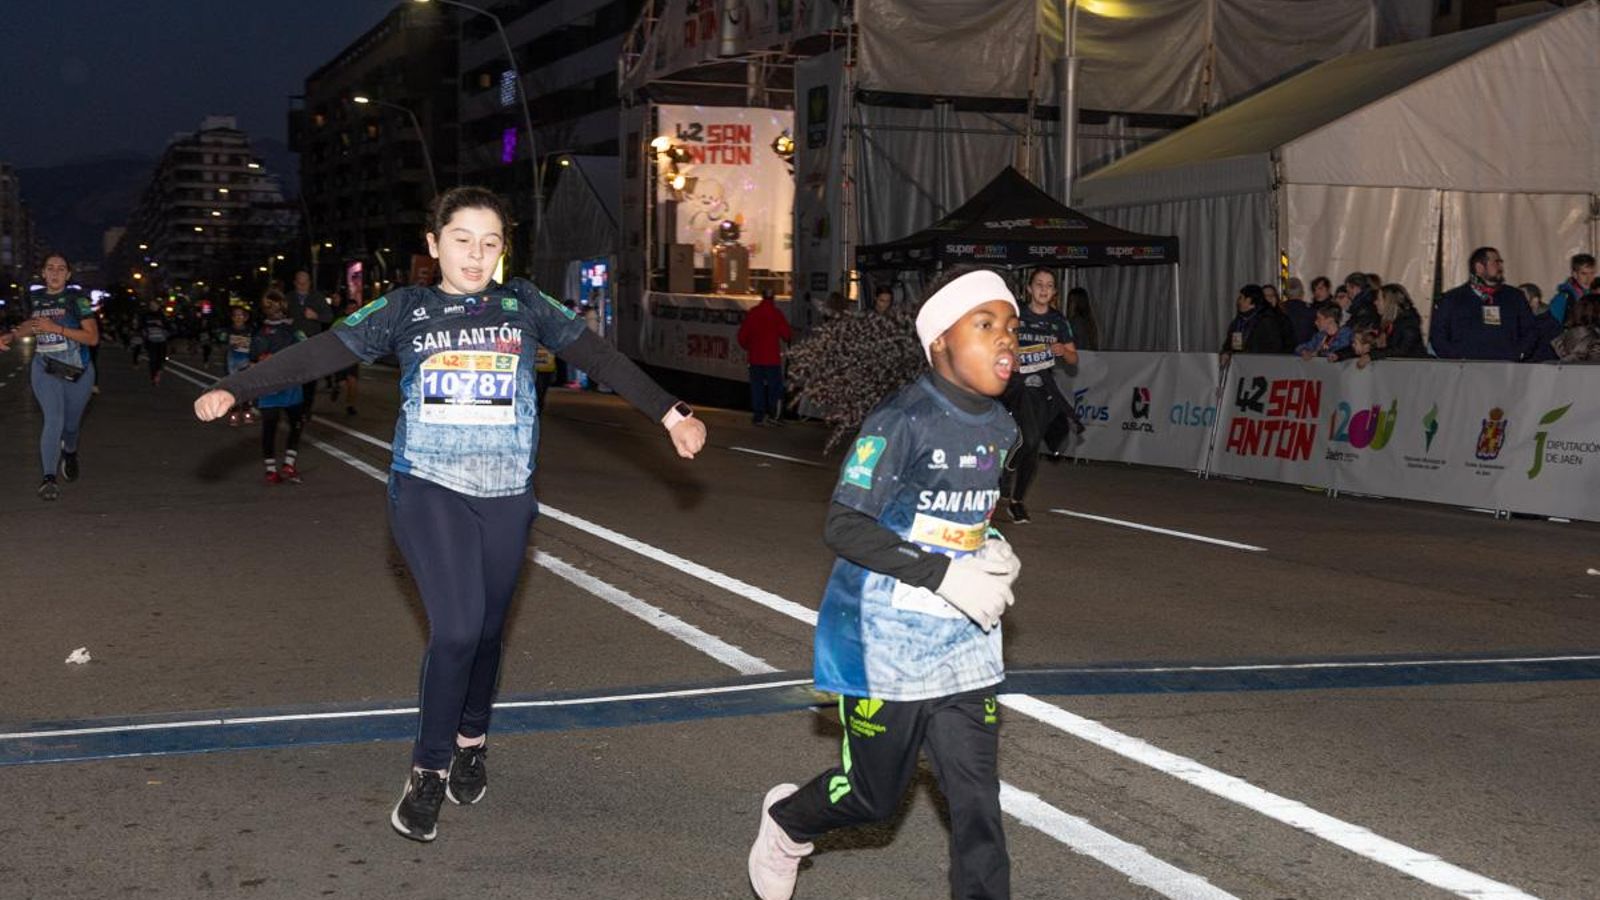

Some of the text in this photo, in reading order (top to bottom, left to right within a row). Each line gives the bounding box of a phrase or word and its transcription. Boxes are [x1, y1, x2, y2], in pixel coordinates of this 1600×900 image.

[675, 122, 751, 144] 42 SAN
[687, 144, 751, 165] NTON
[412, 330, 452, 353] SAN
[457, 322, 522, 347] ANTÓN
[424, 372, 513, 397] 10787
[1235, 375, 1323, 419] 42 SAN
[1169, 400, 1217, 427] alsa
[1225, 416, 1318, 462] ANTON
[1546, 453, 1558, 463] DE
[916, 490, 962, 513] SAN
[942, 528, 964, 545] 42
